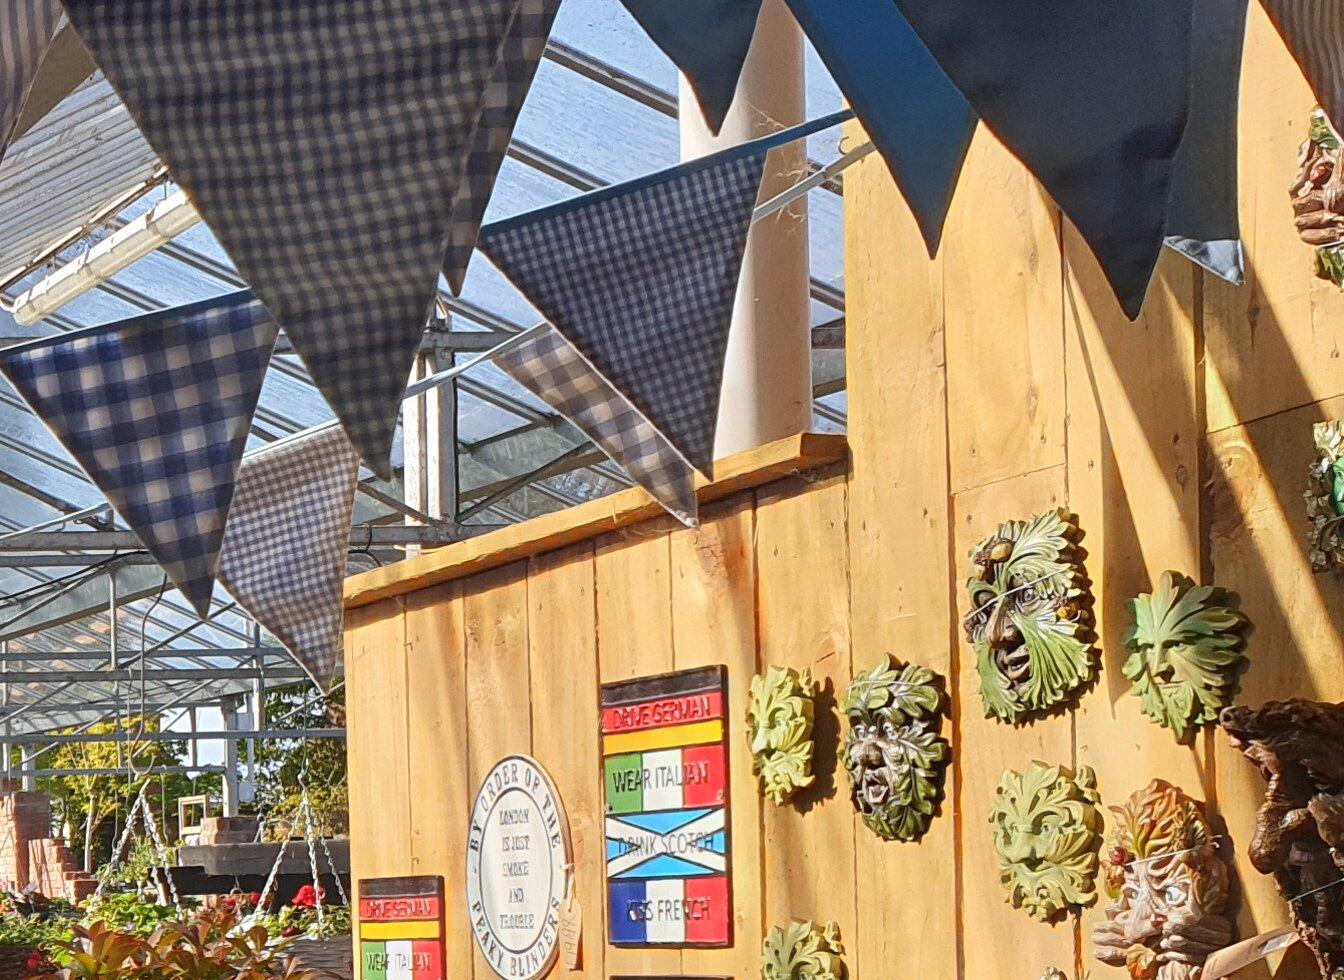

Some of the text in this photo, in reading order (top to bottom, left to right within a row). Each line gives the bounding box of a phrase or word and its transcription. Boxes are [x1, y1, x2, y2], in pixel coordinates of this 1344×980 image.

[614, 696, 711, 729] DRIVE GERMAN
[613, 761, 709, 793] WEAR ITALIAN
[469, 763, 561, 853] BY ORDER OF THE
[499, 809, 530, 826] LONDON
[502, 835, 530, 852] IS JUST
[618, 832, 714, 856] DRINK SCOTCH
[502, 861, 529, 877] SMOKE
[508, 887, 524, 903] AND
[627, 896, 711, 922] KISS FRENCH
[500, 914, 535, 930] TROUBLE
[472, 897, 560, 977] PEAKY BLINDERS
[366, 952, 431, 971] WEAR ITALIAN
